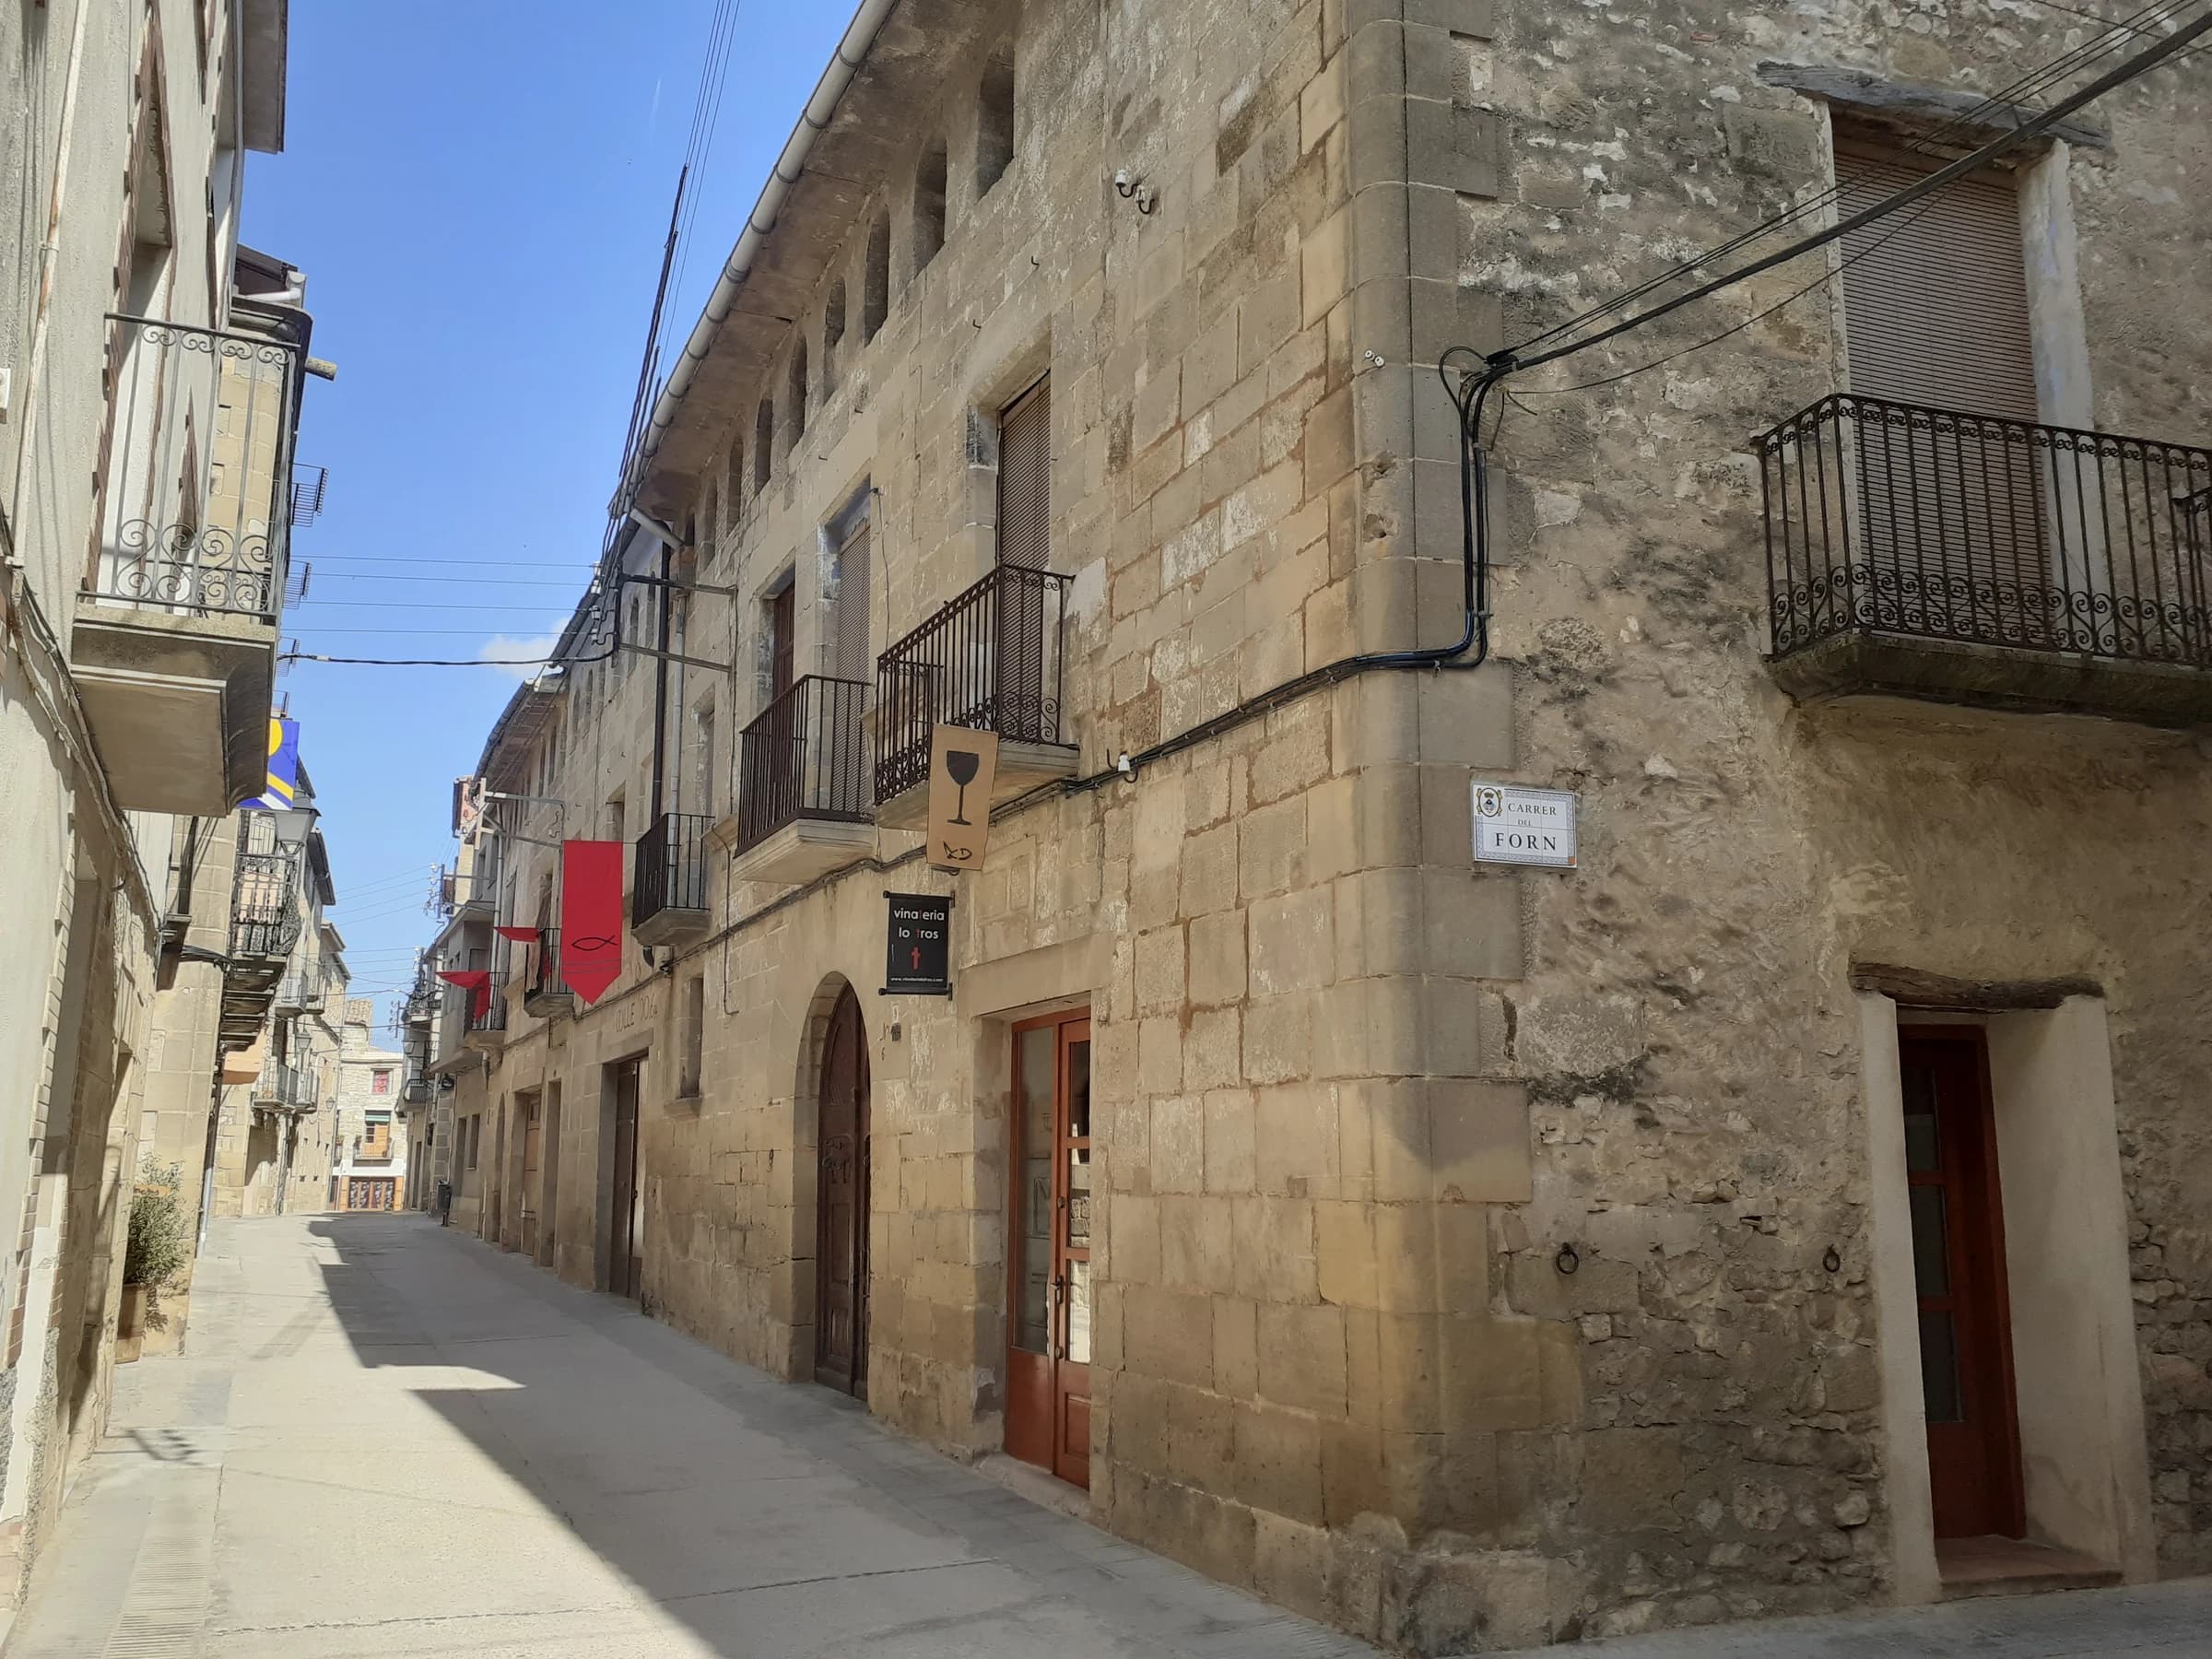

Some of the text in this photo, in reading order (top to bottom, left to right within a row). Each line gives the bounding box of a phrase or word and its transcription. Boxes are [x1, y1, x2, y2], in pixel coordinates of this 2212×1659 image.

[1508, 803, 1557, 816] CARRER
[1517, 818, 1532, 827] DEL
[1495, 832, 1556, 851] FORN
[899, 926, 939, 939] lo tros
